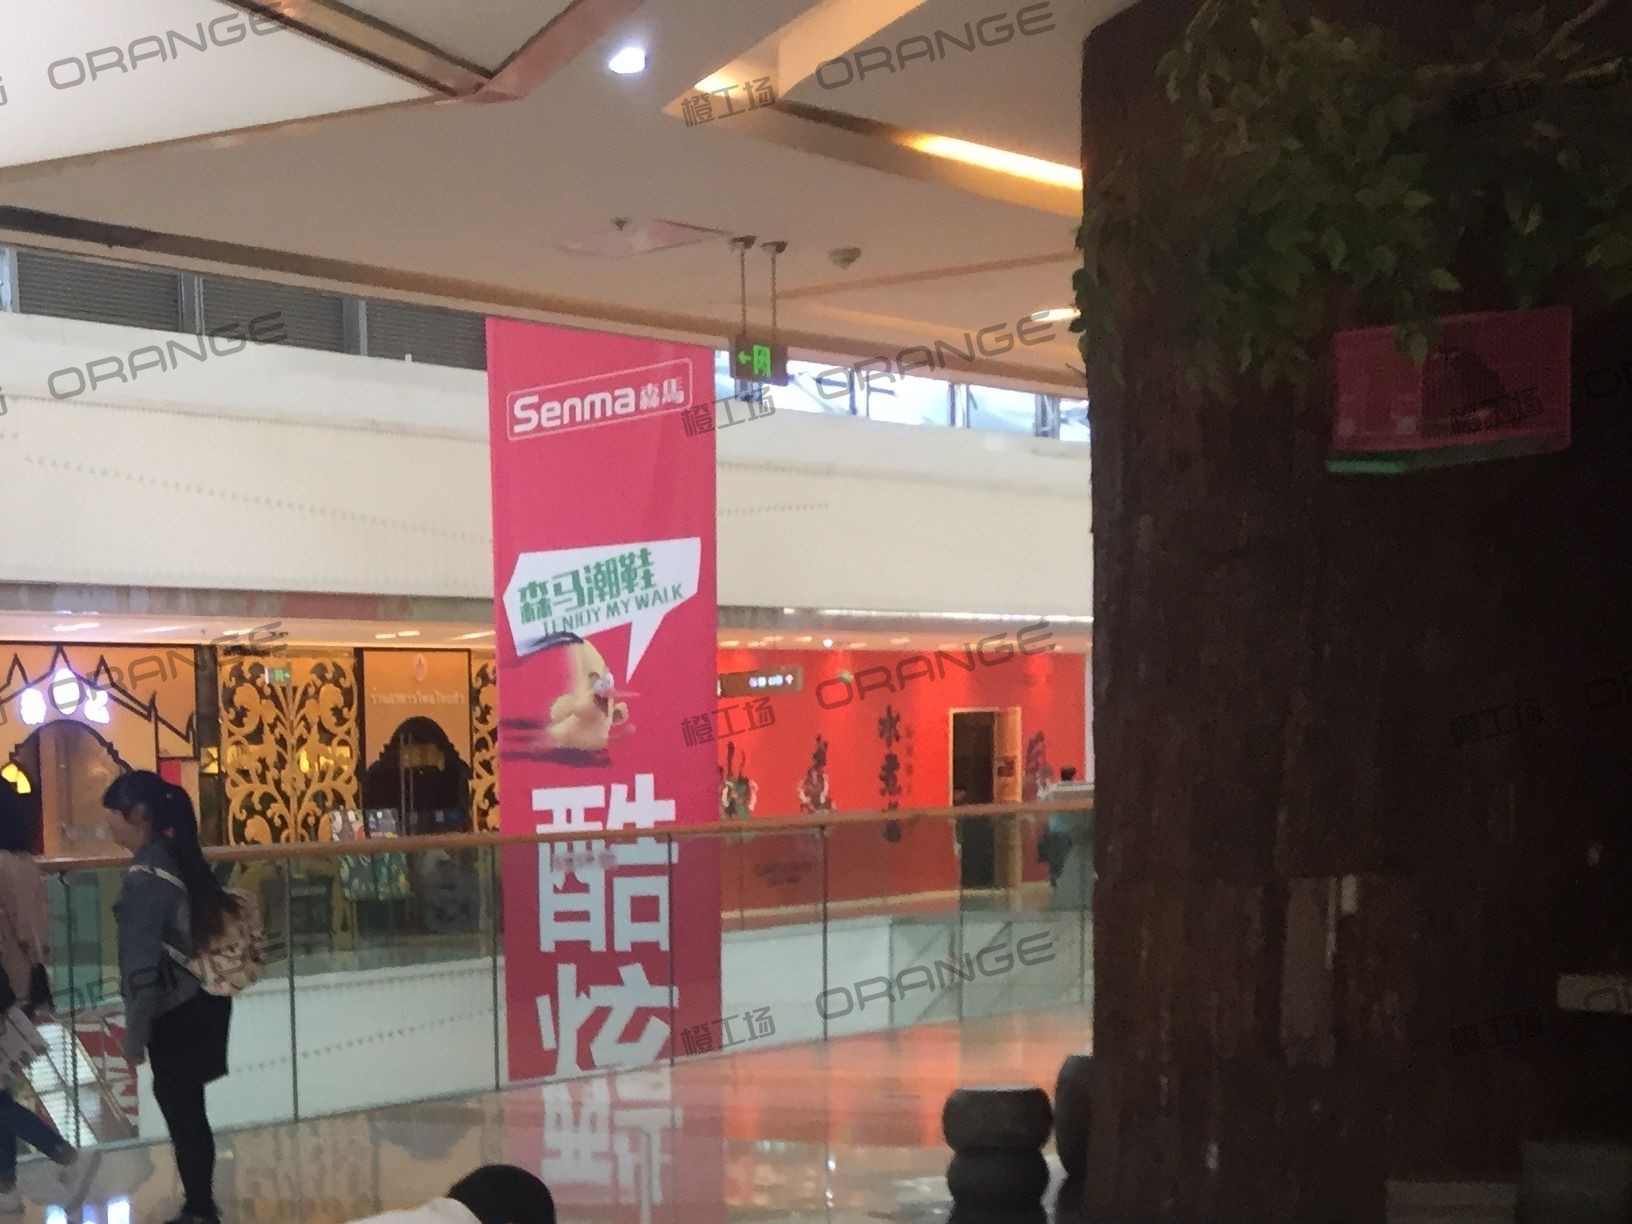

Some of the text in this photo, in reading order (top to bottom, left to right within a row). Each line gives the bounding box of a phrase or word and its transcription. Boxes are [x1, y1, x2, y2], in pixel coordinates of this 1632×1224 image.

[513, 387, 635, 434] Senma
[518, 547, 657, 625] 森马潮鞋
[606, 597, 631, 620] MY
[636, 583, 683, 611] WALK
